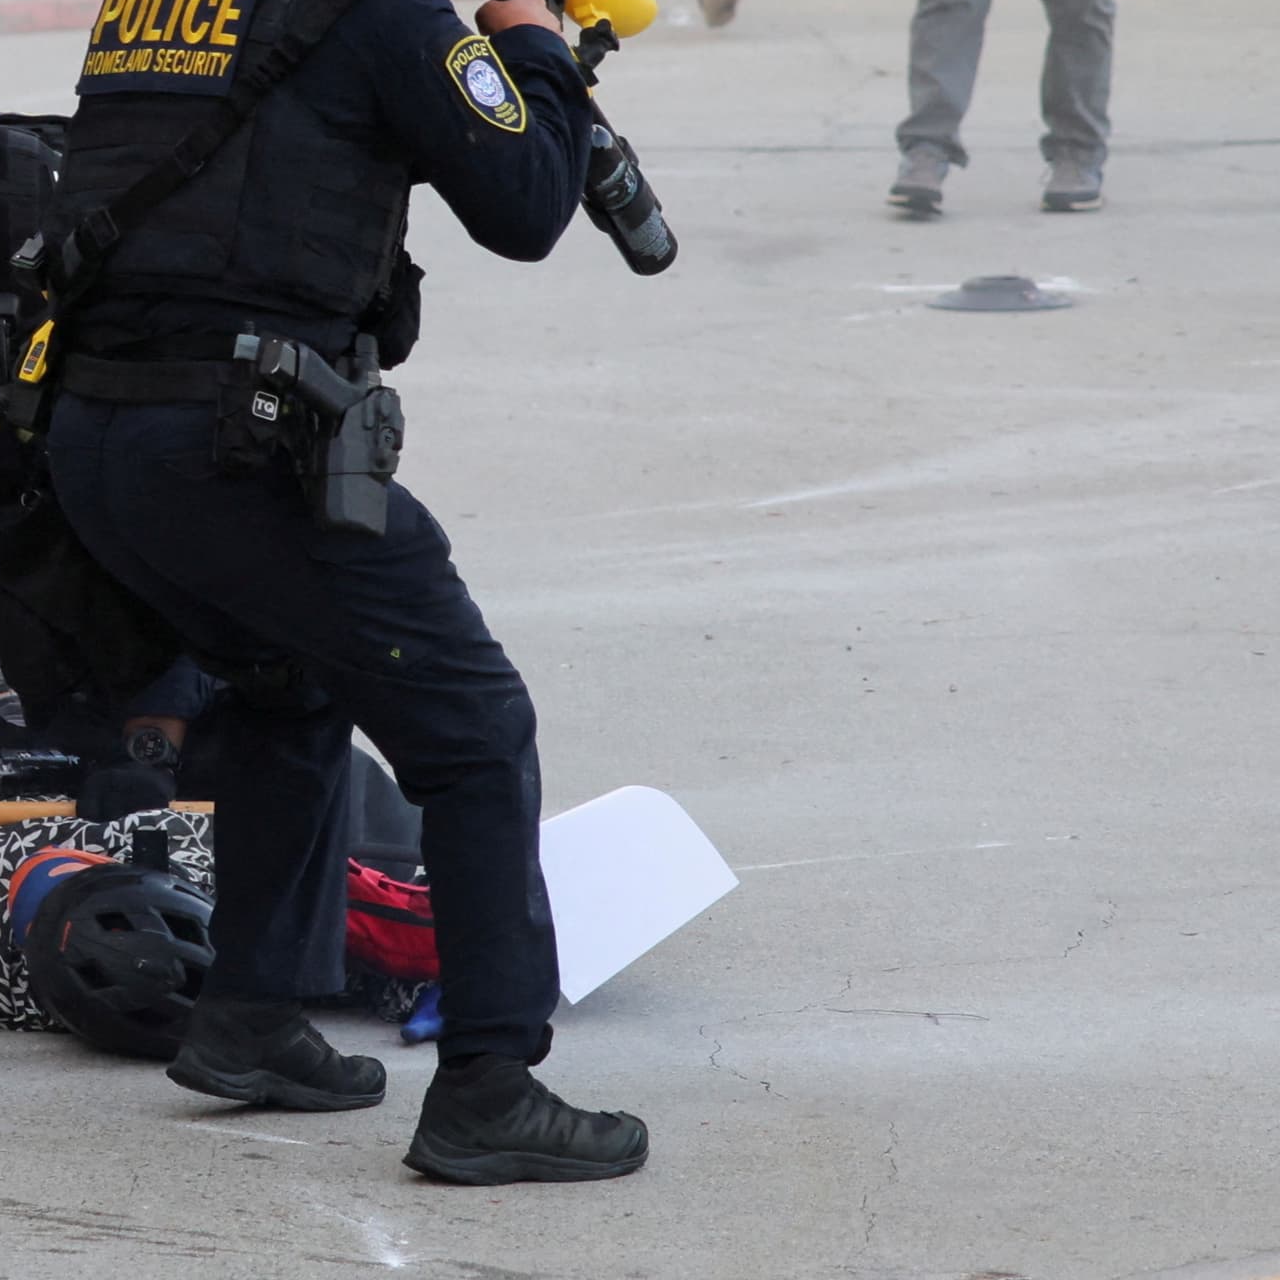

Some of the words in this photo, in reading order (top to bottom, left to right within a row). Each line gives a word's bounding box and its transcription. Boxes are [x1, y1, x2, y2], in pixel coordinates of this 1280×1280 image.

[83, 48, 153, 76] HOMELAND
[153, 48, 233, 78] SECURITY
[451, 42, 490, 75] POLICE
[255, 397, 275, 414] TQ
